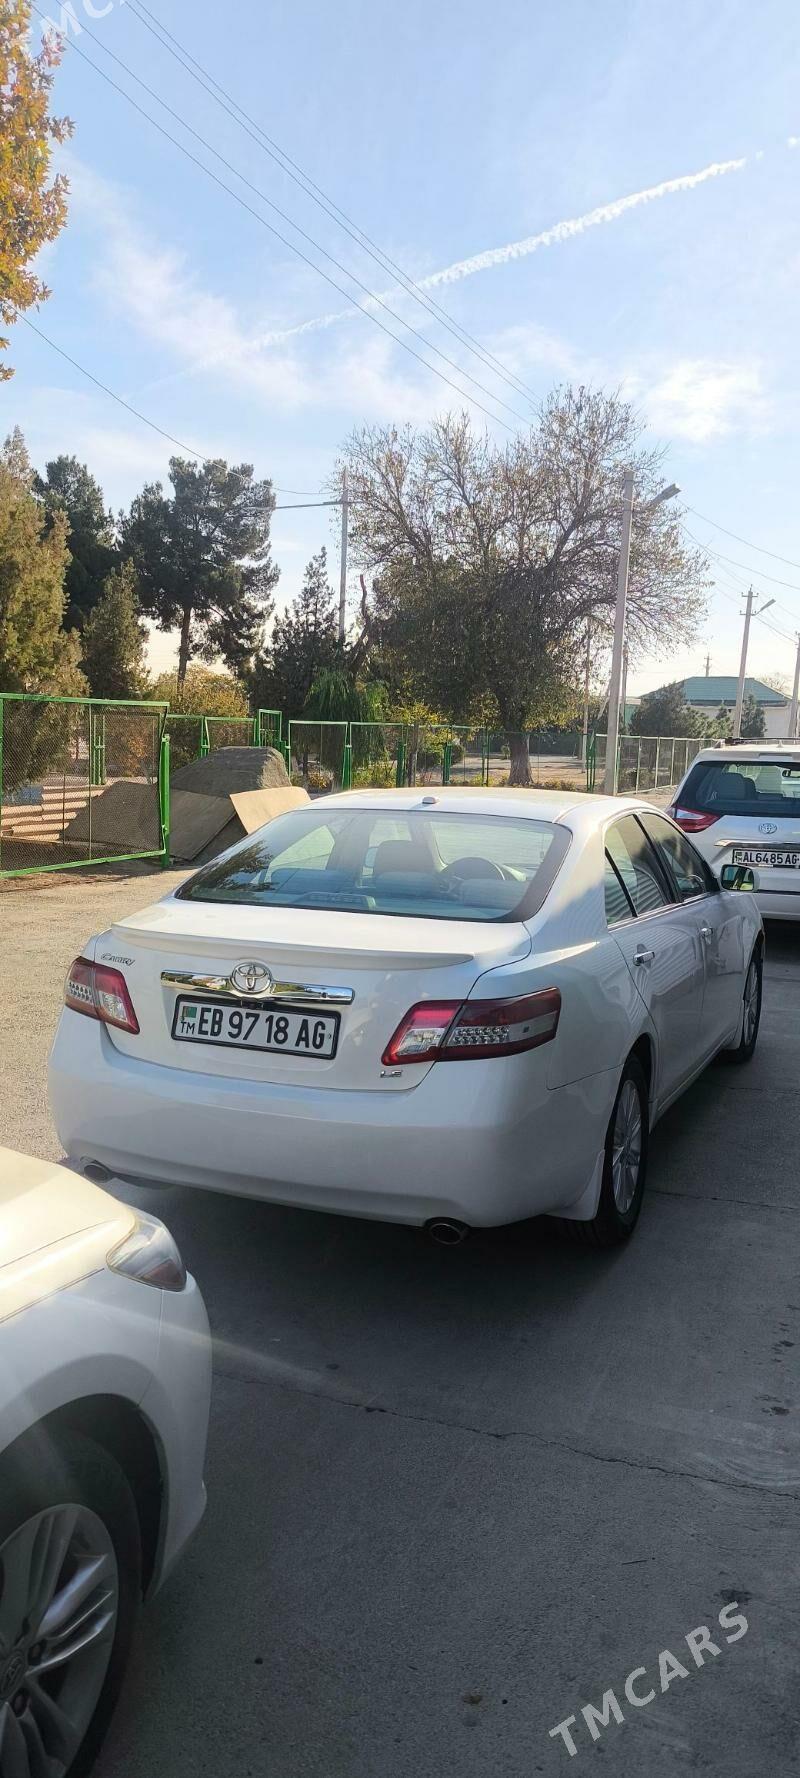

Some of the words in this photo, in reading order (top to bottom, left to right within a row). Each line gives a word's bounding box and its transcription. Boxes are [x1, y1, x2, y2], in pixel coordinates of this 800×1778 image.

[181, 1021, 195, 1035] TM
[198, 1008, 223, 1037] EB
[228, 1011, 260, 1040] 97
[265, 1015, 289, 1044] 18
[295, 1019, 326, 1049] AG
